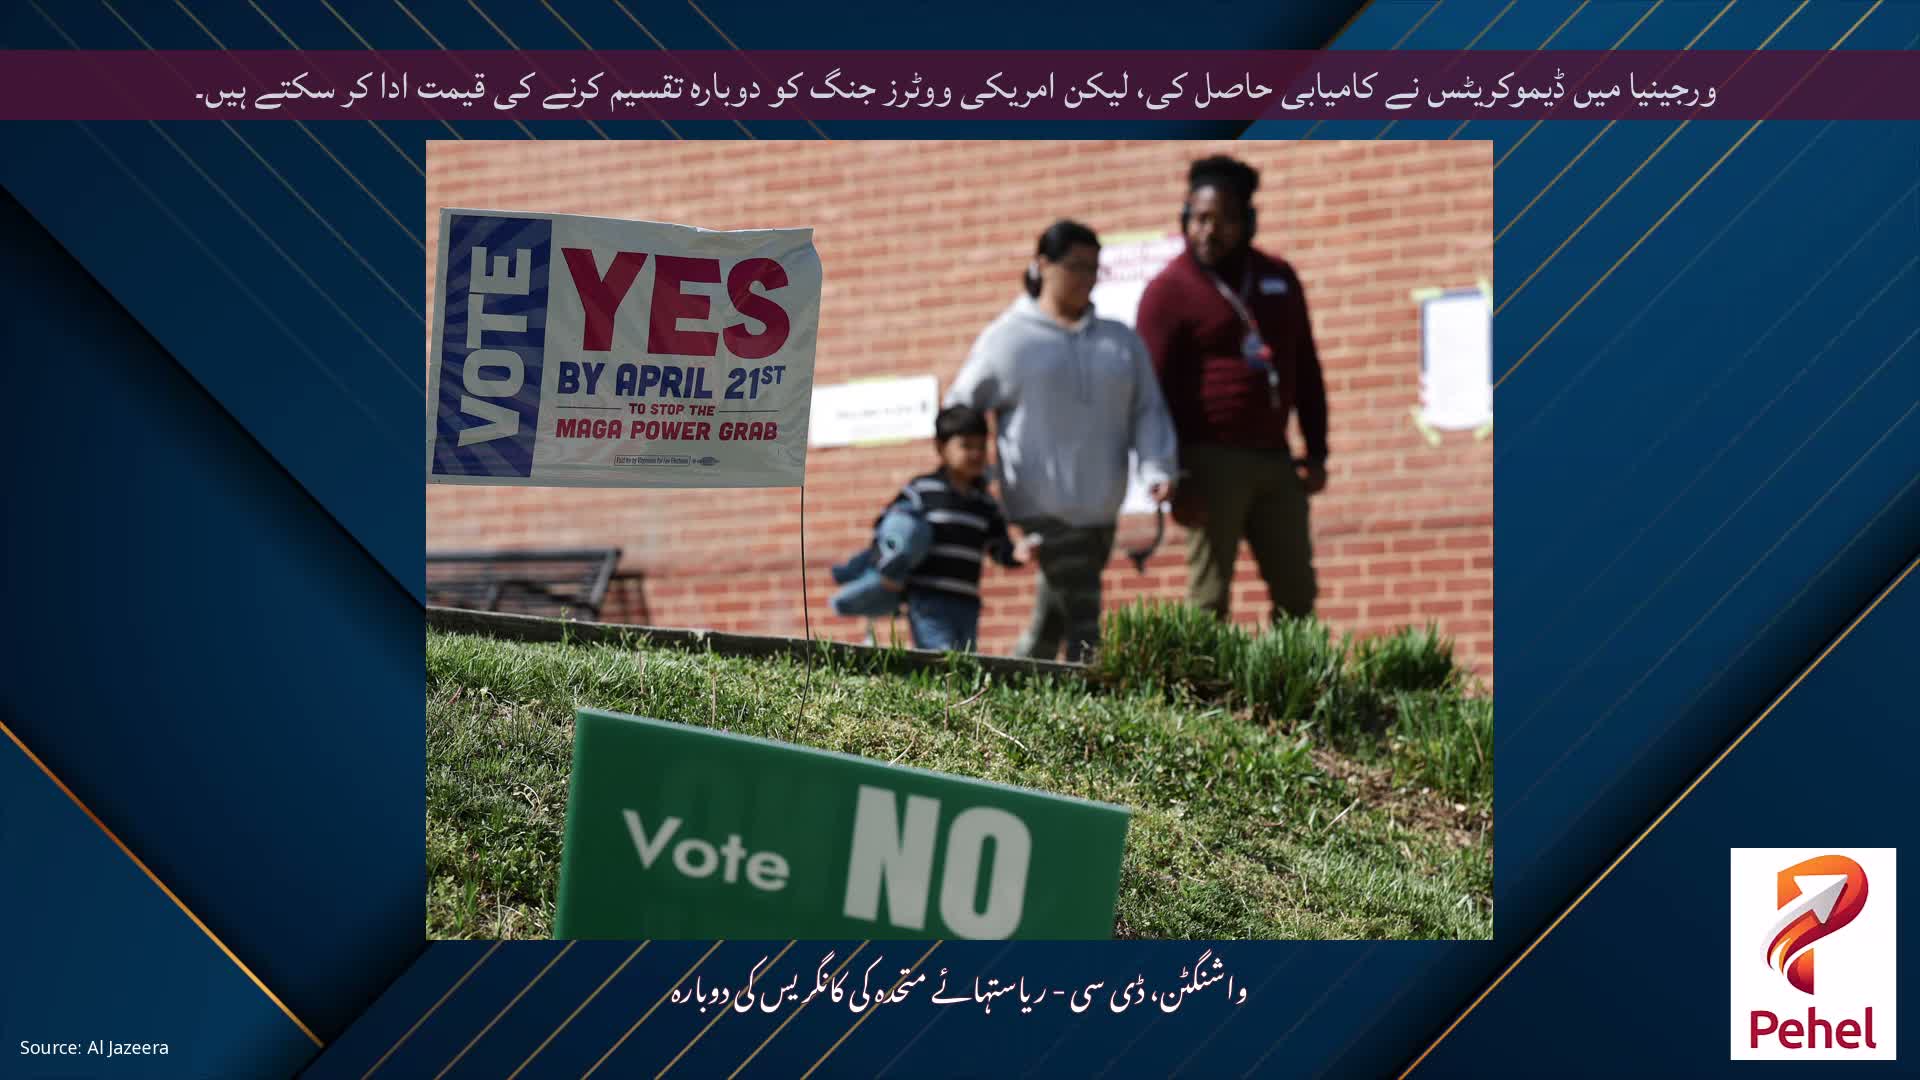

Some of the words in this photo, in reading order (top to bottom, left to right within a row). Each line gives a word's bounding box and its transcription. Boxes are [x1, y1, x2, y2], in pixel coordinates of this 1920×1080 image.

[560, 247, 792, 360] YES
[457, 246, 532, 448] VOTE
[557, 361, 607, 395] BY
[615, 362, 714, 400] APRIL
[723, 364, 786, 401] 21ST
[555, 418, 622, 439] MAGA
[630, 420, 711, 441] POWER
[718, 421, 778, 442] GRAB
[629, 402, 648, 416] TO
[650, 403, 686, 416] STOP
[688, 404, 715, 417] THE
[622, 807, 791, 892] Vote
[843, 783, 1032, 940] NO
